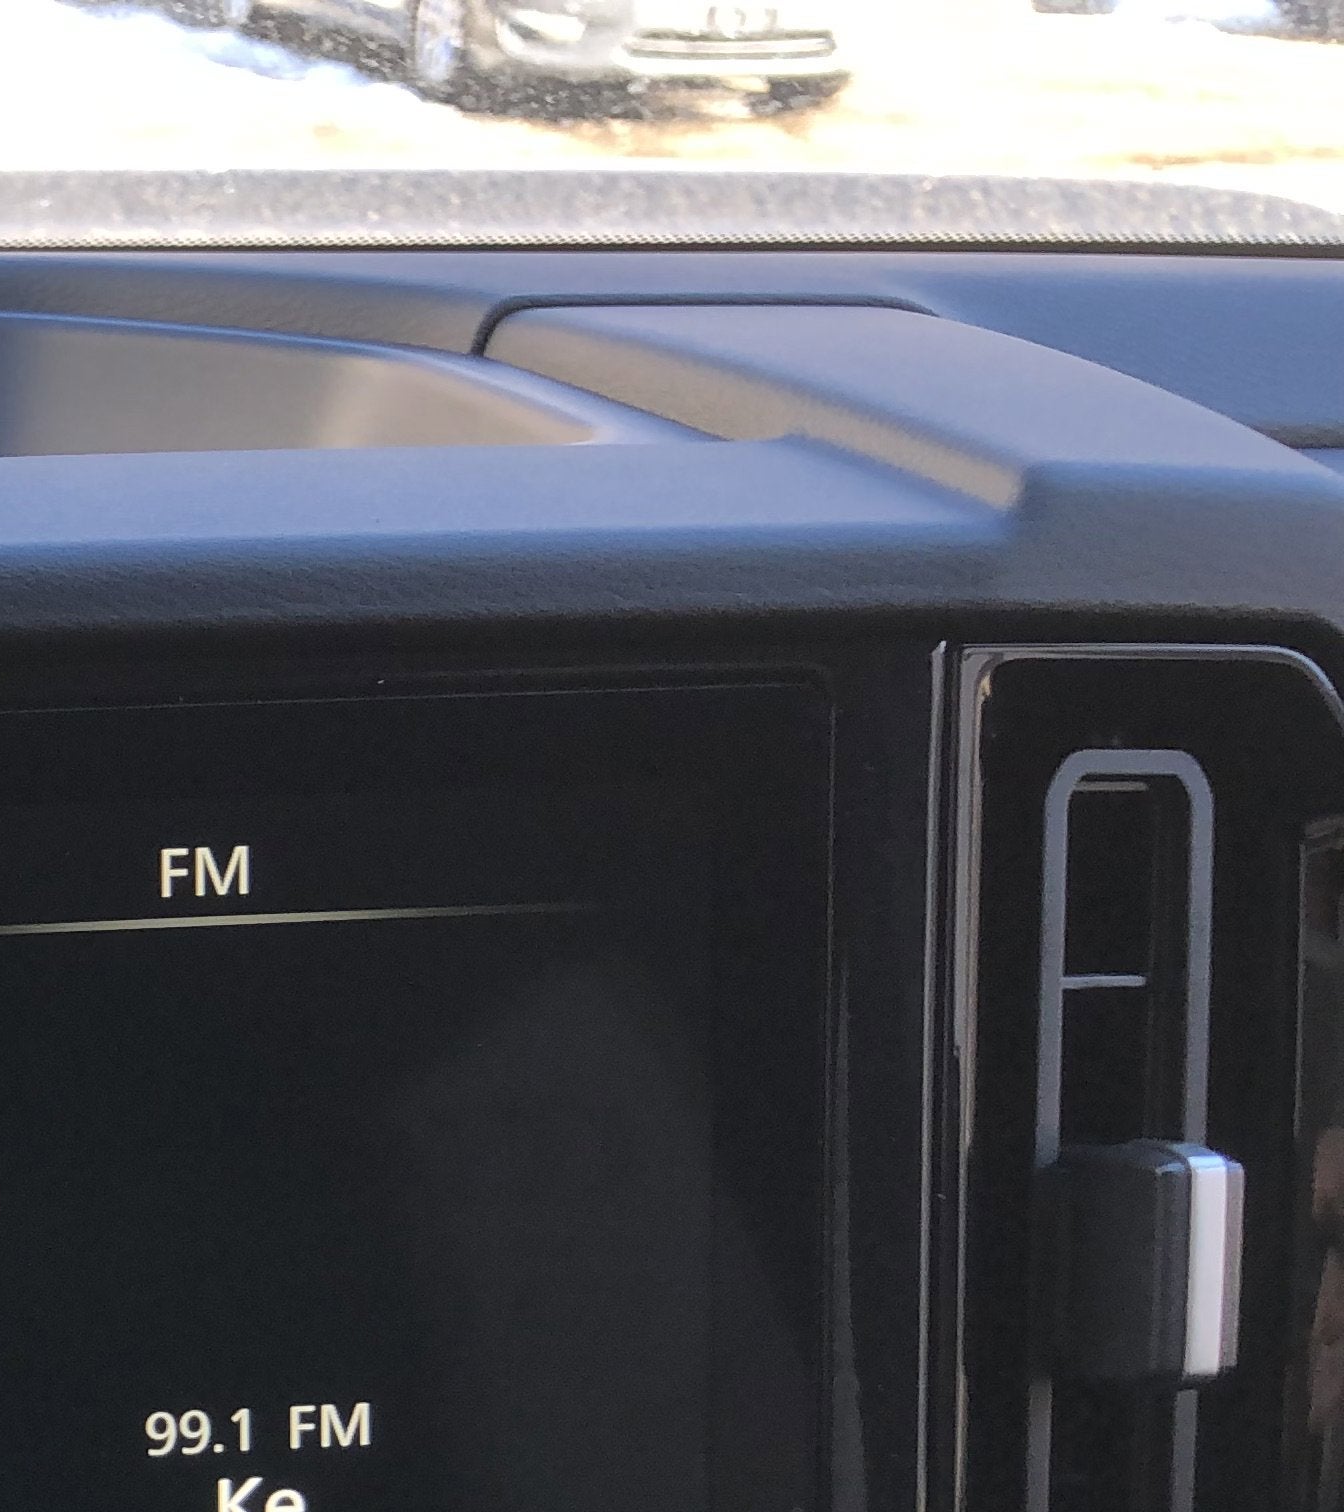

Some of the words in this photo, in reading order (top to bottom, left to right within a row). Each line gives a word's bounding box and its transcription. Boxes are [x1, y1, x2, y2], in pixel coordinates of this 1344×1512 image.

[158, 846, 252, 897] FM
[144, 1410, 254, 1457] 99.1
[287, 1403, 372, 1449] FM
